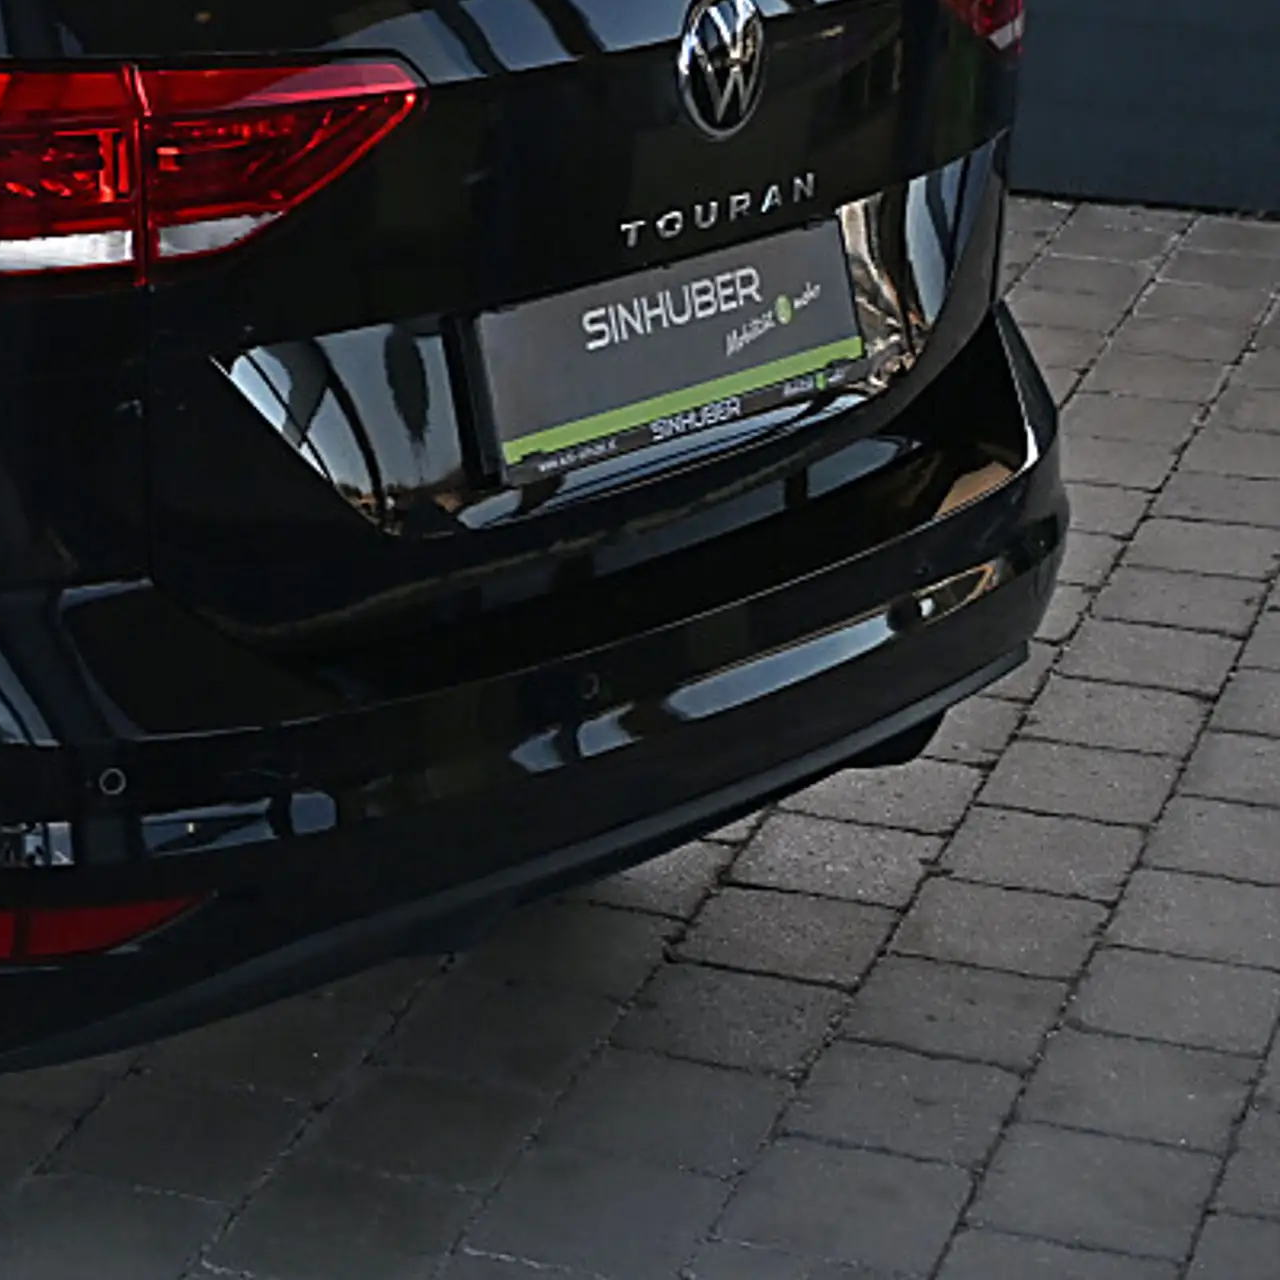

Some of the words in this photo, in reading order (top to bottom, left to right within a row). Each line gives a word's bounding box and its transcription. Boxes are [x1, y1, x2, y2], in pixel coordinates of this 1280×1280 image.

[620, 172, 816, 248] TOURAN
[582, 265, 763, 351] SINHUBER
[649, 396, 742, 441] SINHUBER
